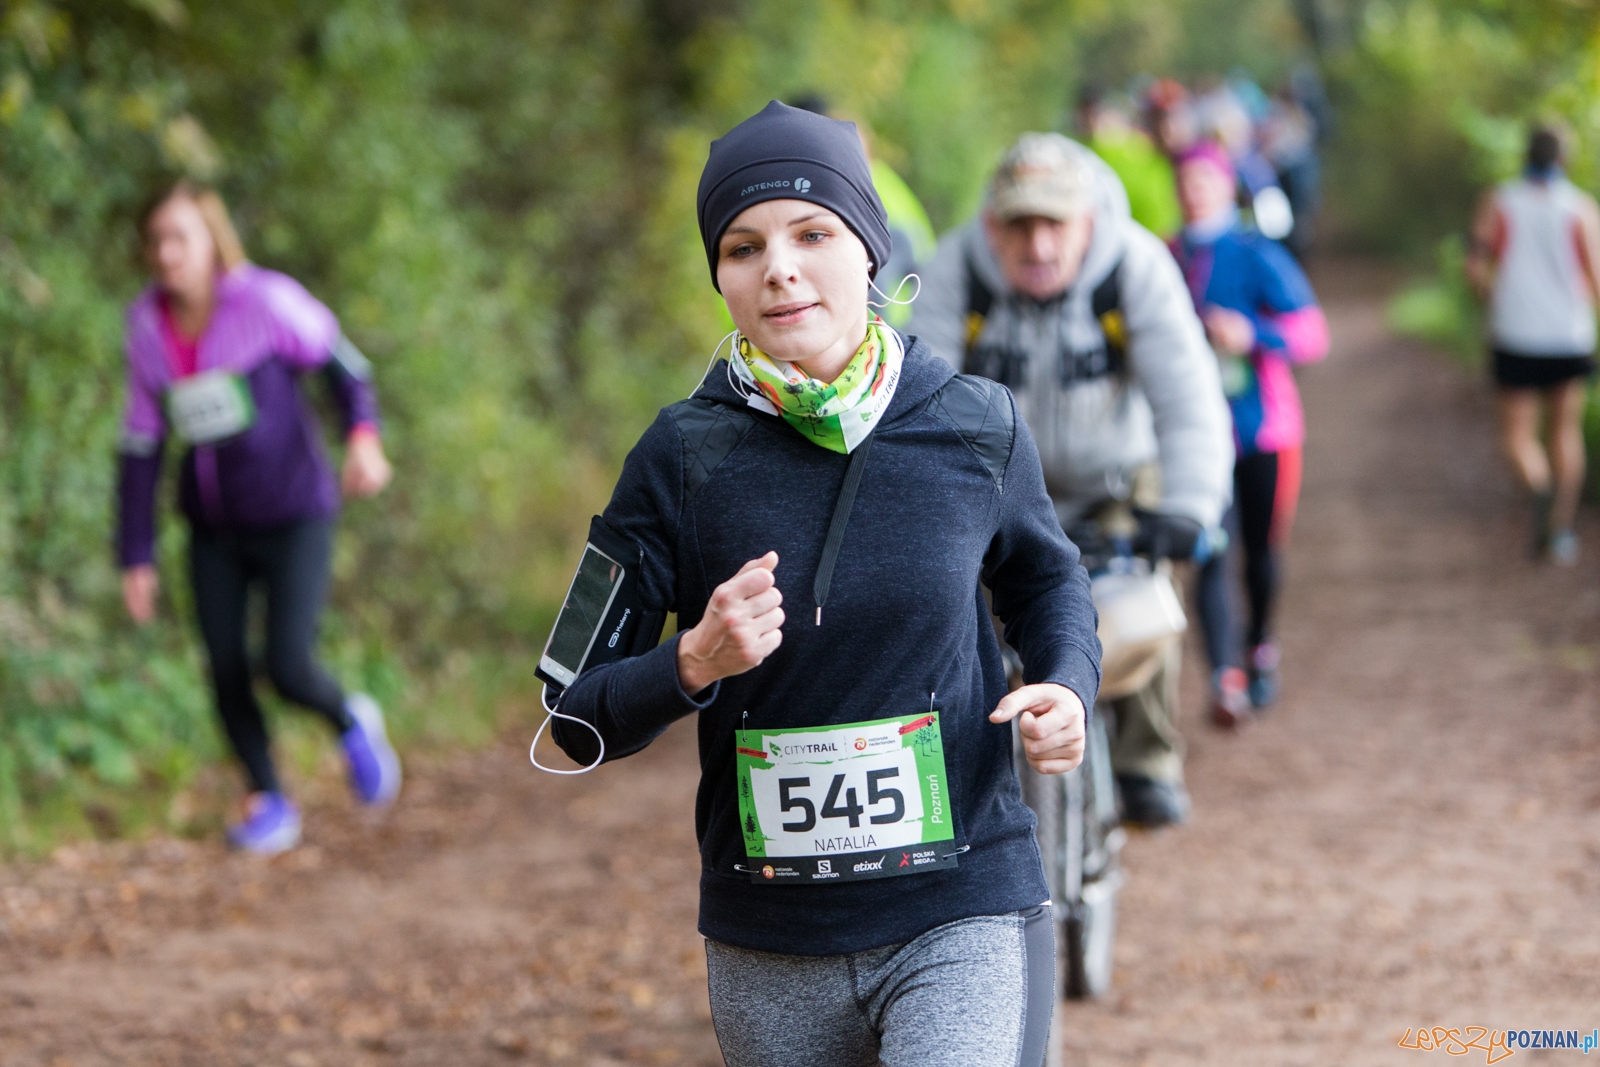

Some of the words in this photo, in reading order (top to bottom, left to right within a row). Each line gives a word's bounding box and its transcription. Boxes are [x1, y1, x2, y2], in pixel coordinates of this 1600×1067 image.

[740, 180, 790, 196] ARTENGO
[778, 766, 906, 833] 545
[926, 774, 943, 824] Poznań
[814, 834, 877, 852] NATALIA
[912, 850, 936, 859] POLSKA
